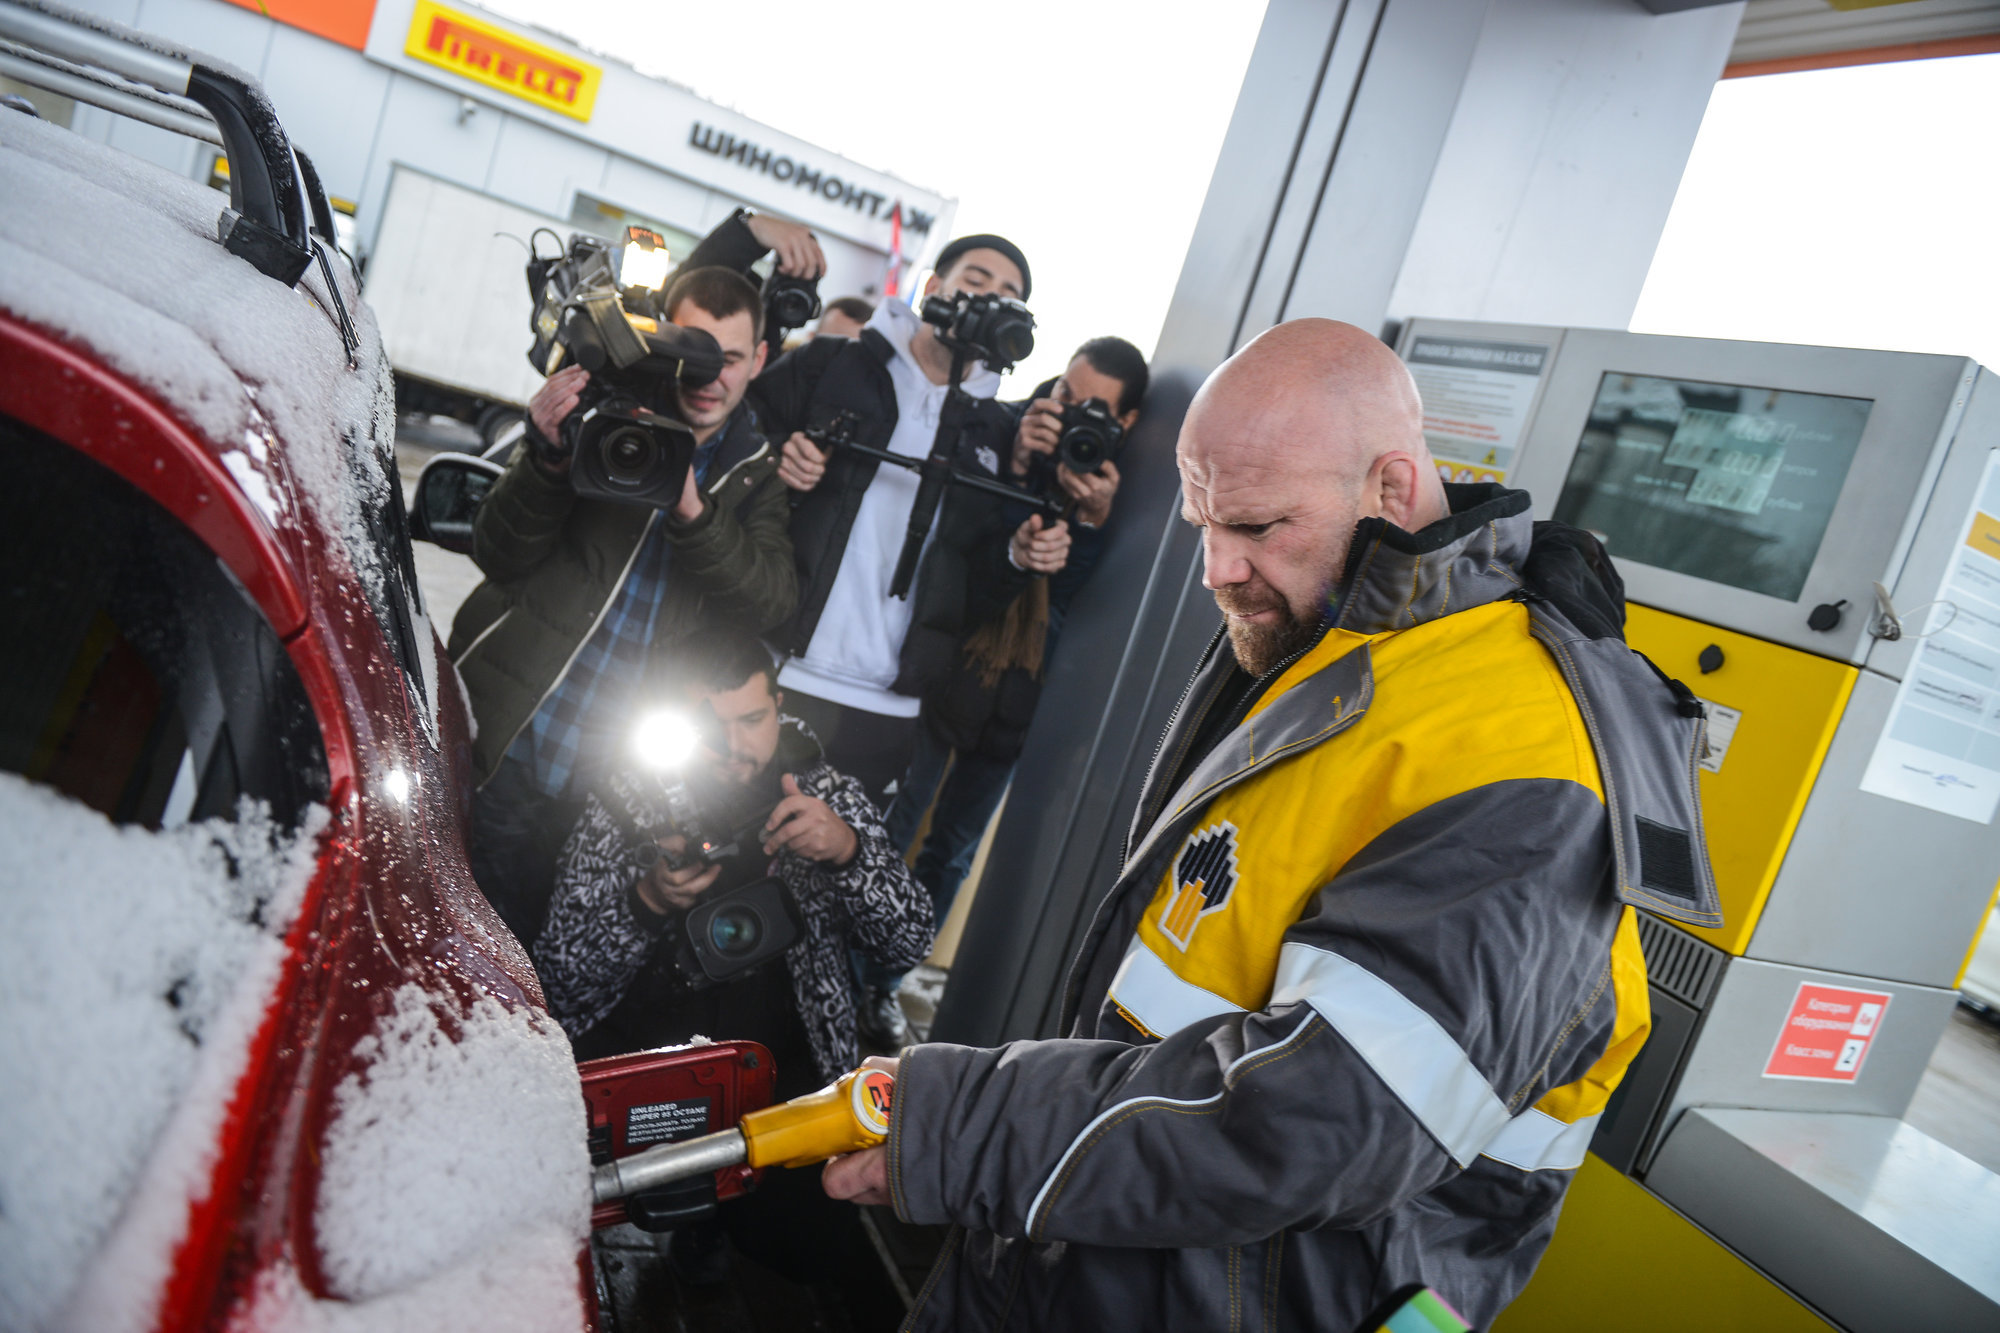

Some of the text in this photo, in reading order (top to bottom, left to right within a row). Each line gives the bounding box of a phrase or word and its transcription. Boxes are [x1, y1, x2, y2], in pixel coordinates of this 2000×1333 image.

[427, 14, 583, 103] PIRELLI
[689, 121, 936, 235] ШИНОМОНТАЖ
[1843, 1046, 1857, 1064] 2
[629, 1112, 660, 1122] SUPER
[672, 1105, 707, 1117] OCTANE
[630, 1103, 678, 1115] UNLEADED
